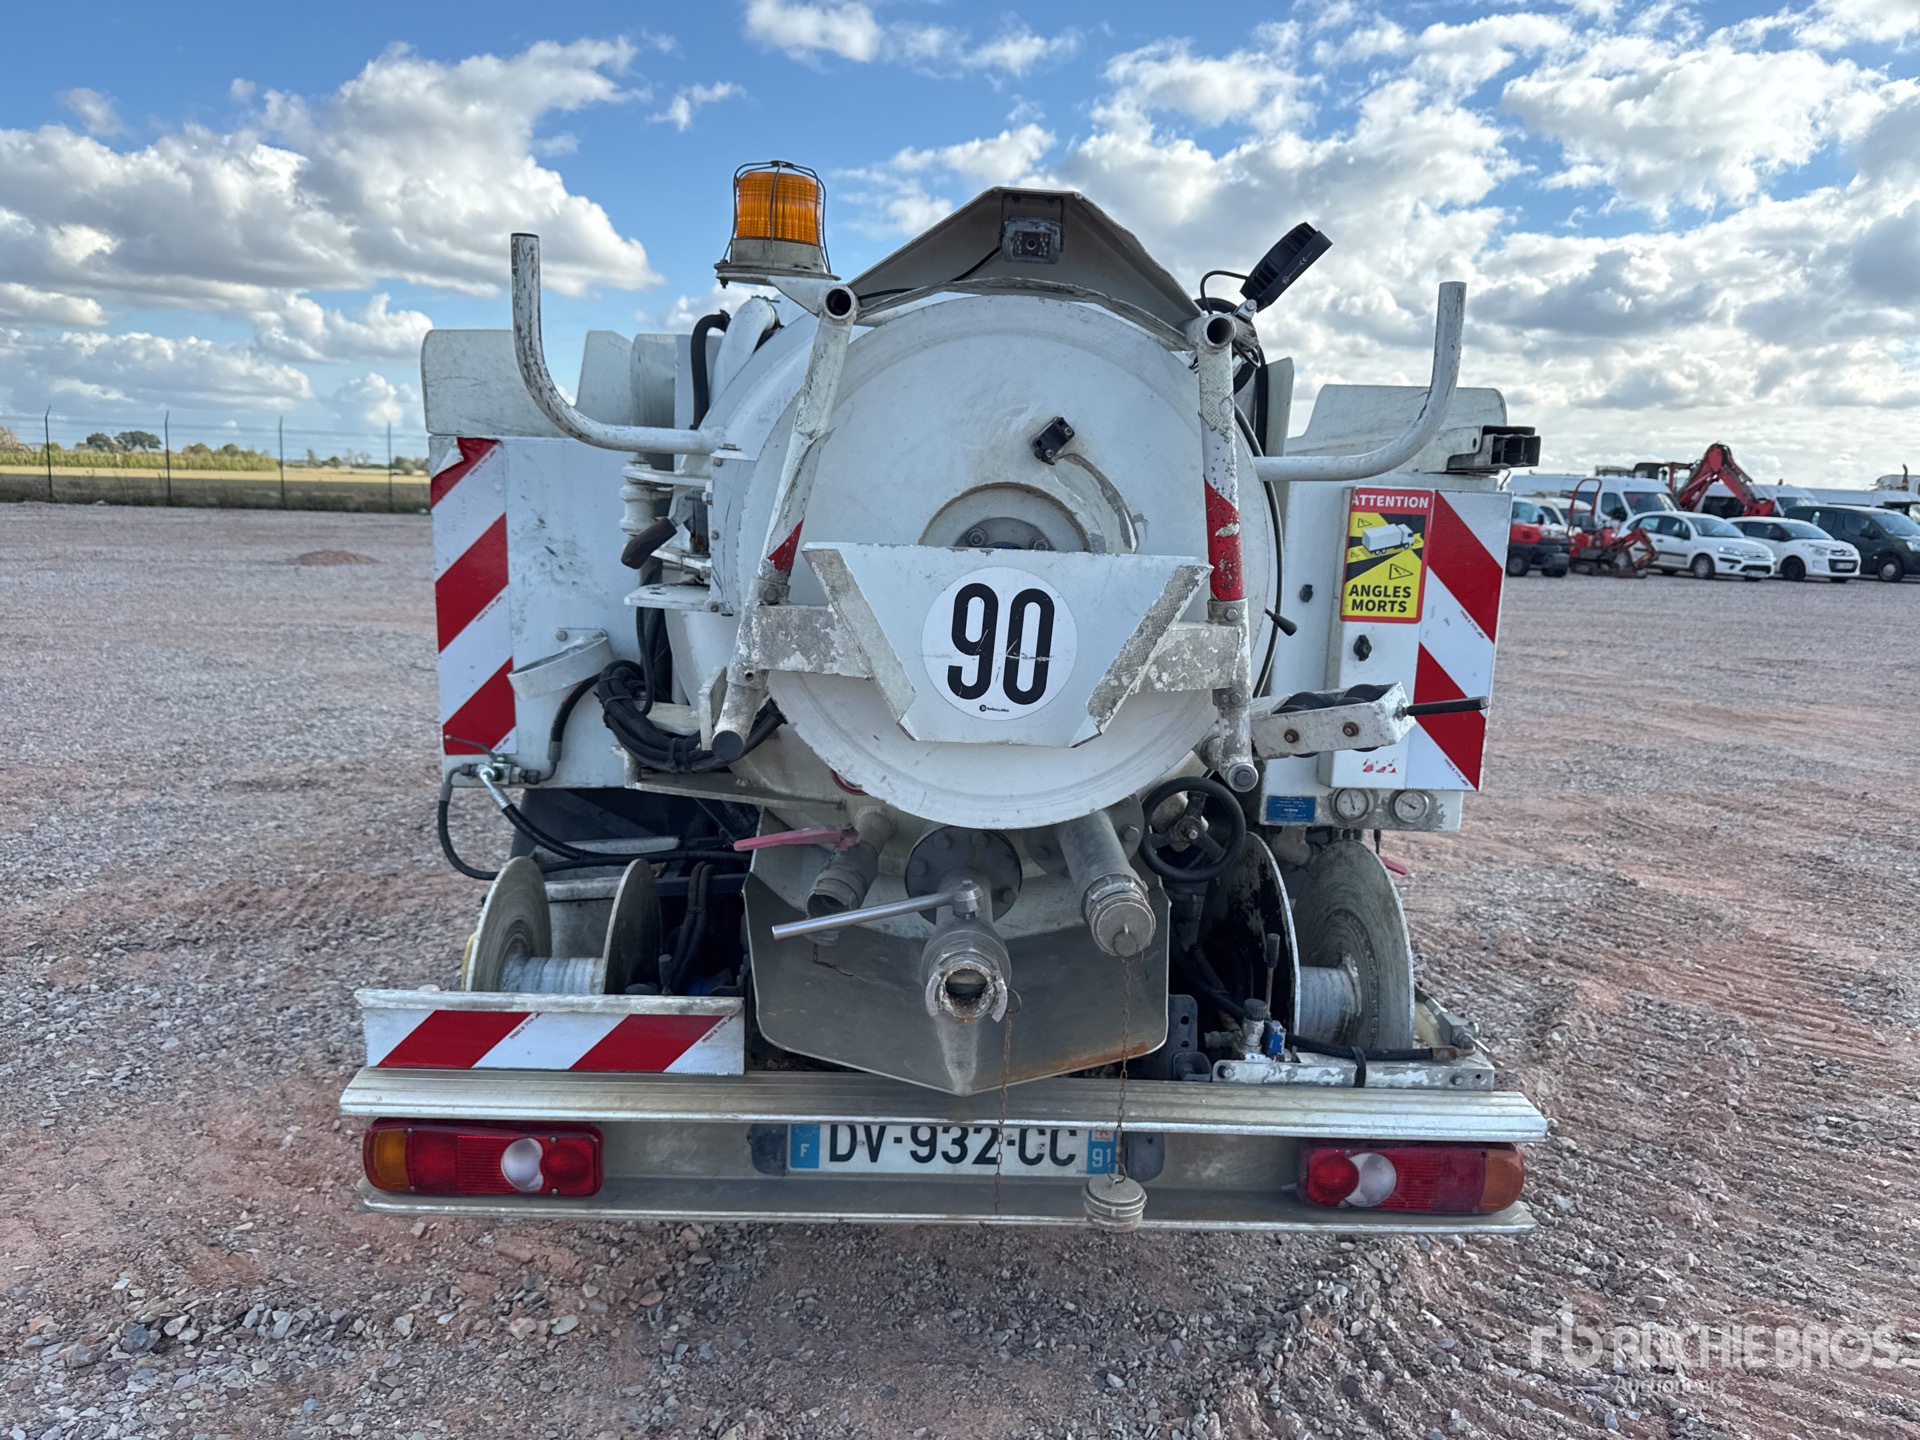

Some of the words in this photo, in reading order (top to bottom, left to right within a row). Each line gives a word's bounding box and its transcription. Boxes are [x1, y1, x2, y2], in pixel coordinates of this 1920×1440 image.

[1352, 495, 1428, 508] ATTENTION
[1349, 585, 1411, 598] ANGLES
[1351, 599, 1407, 612] MORTS
[947, 583, 1055, 704] 90
[800, 1145, 808, 1157] F
[829, 1124, 1077, 1166] DV-932-CC
[1092, 1148, 1112, 1168] 91
